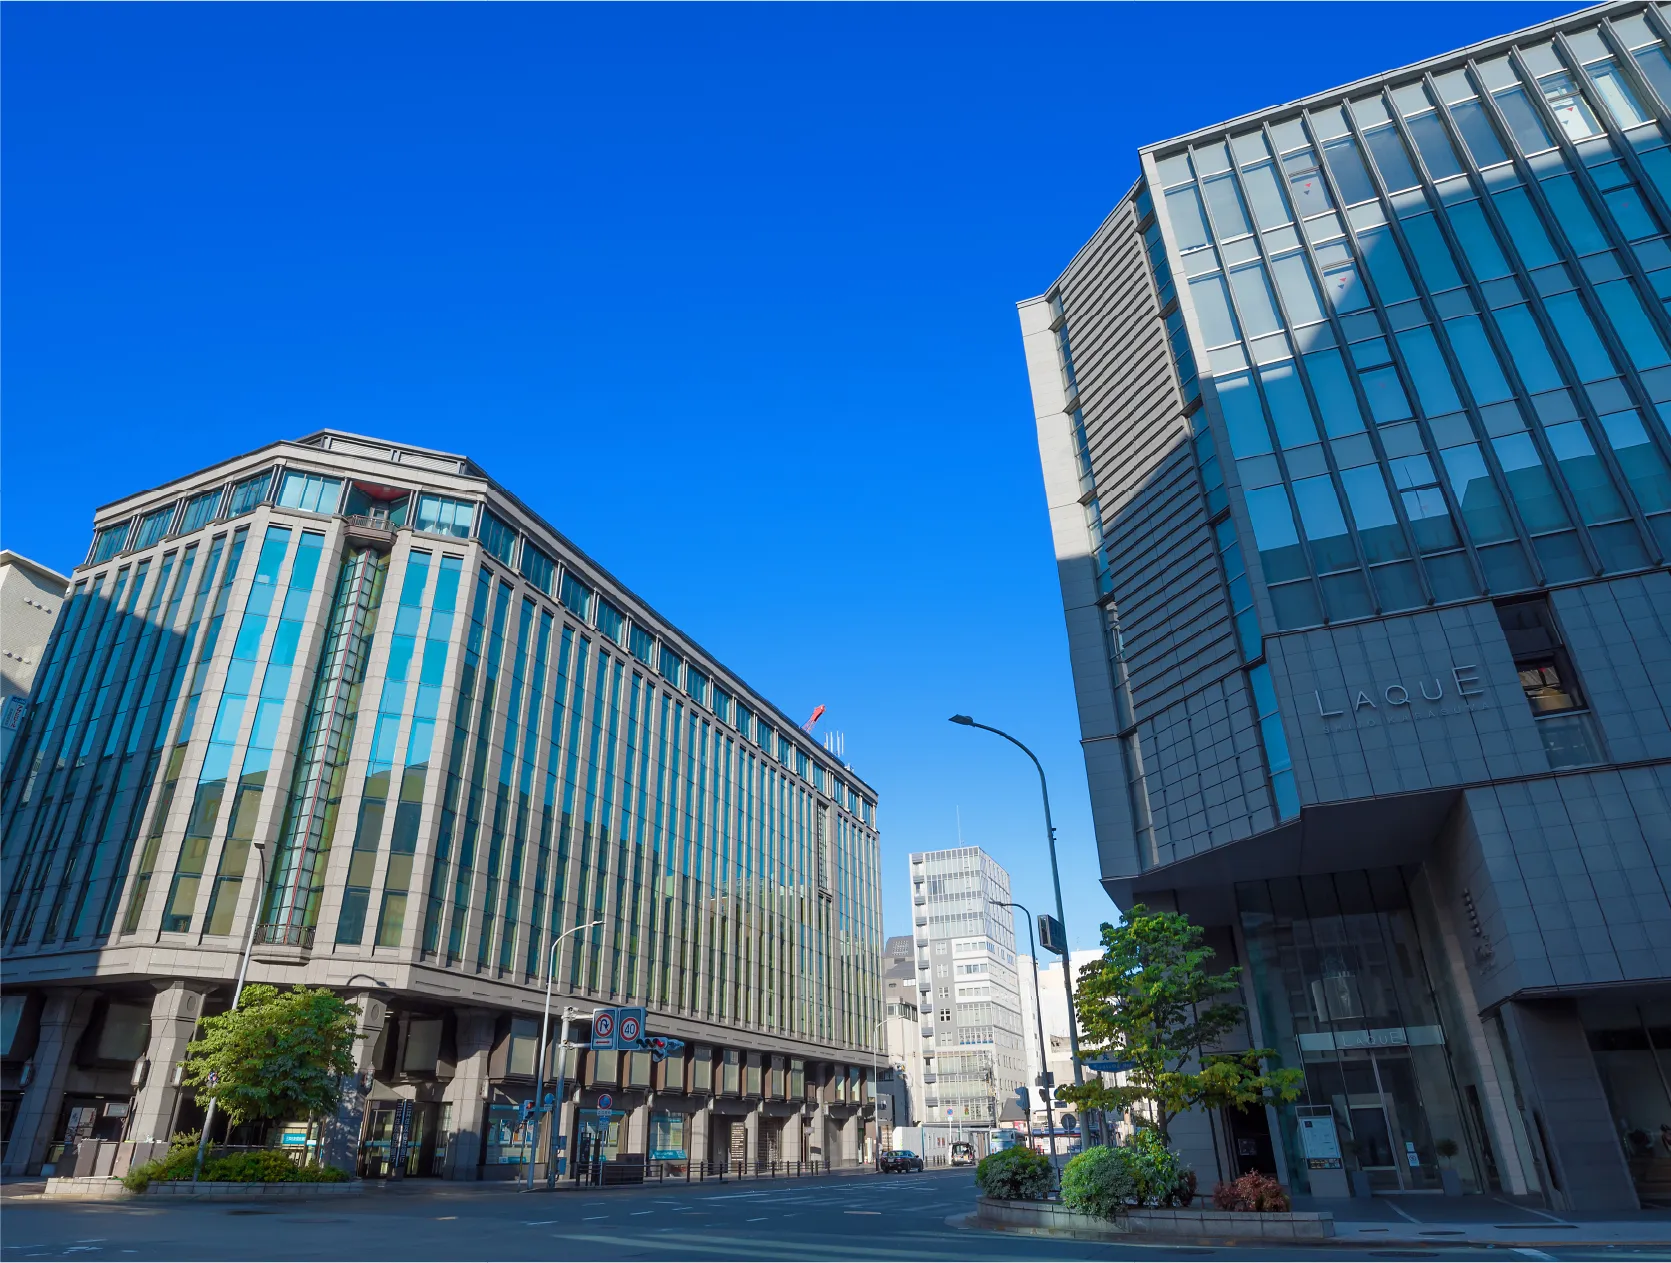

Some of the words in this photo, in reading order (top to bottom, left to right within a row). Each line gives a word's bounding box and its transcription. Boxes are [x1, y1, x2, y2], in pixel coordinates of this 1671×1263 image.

[1314, 664, 1485, 717] LAQUE
[1322, 719, 1376, 734] SHIJO
[1387, 701, 1491, 724] KARASUMA
[624, 1023, 636, 1035] 40
[1341, 1031, 1401, 1047] LAQUE
